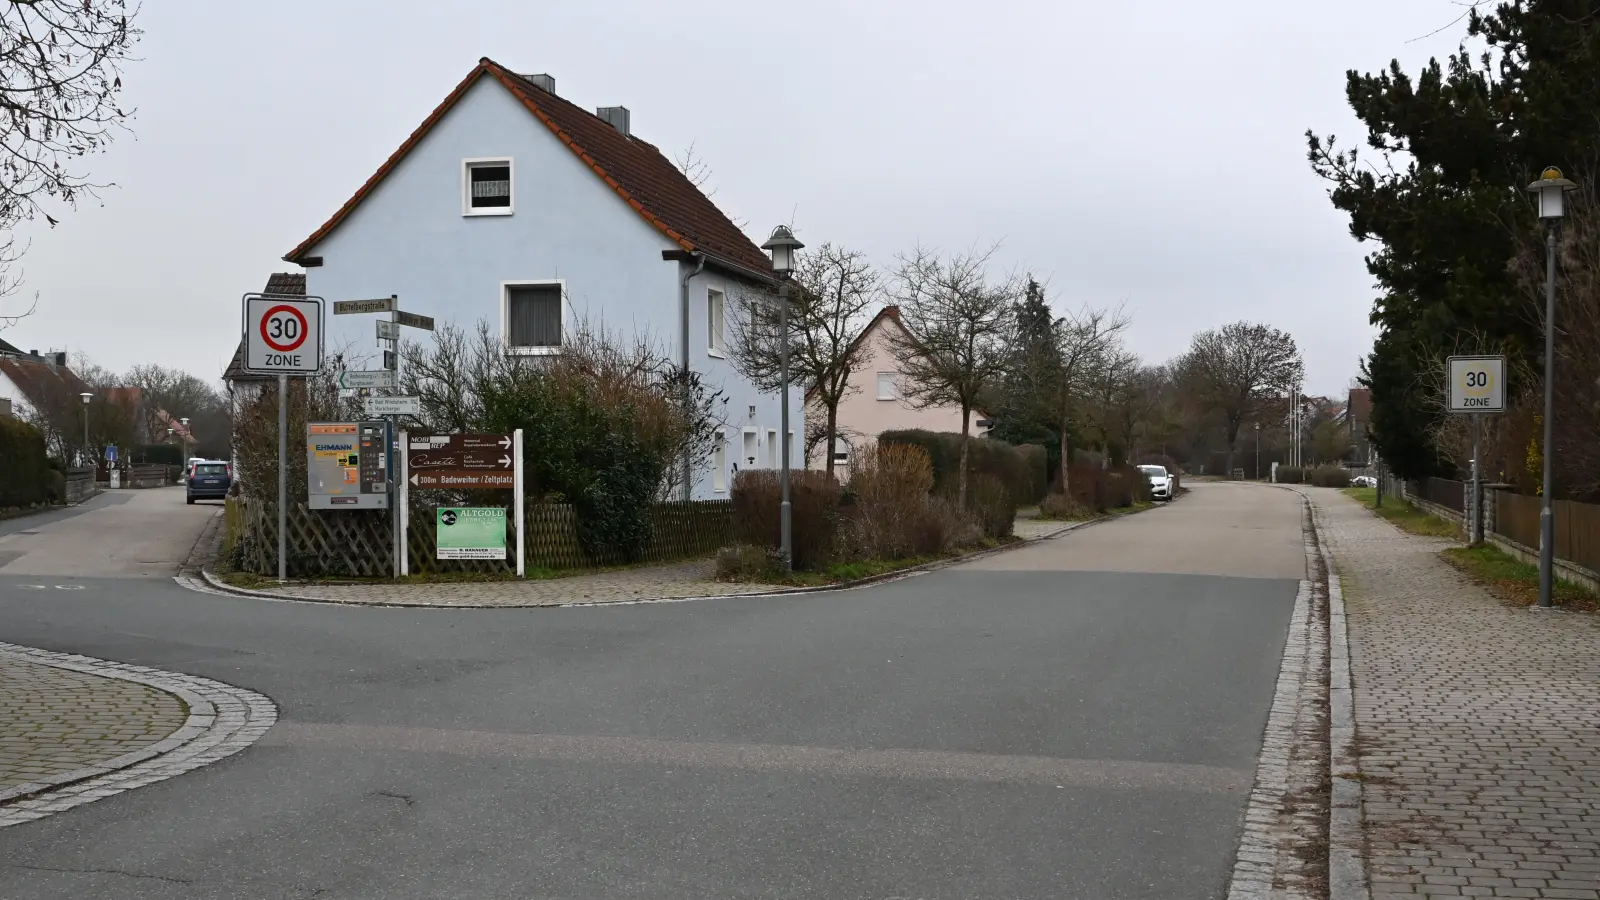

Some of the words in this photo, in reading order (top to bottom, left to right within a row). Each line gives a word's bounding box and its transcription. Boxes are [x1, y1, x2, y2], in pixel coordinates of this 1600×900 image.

[269, 318, 297, 339] 30
[265, 354, 301, 367] ZONE
[1466, 372, 1487, 387] 30
[1463, 397, 1490, 407] ZONE
[420, 476, 437, 484] 300m
[441, 475, 479, 484] Badeweiher
[484, 475, 513, 486] Zeltplatz
[460, 509, 504, 517] ALTGOLD
